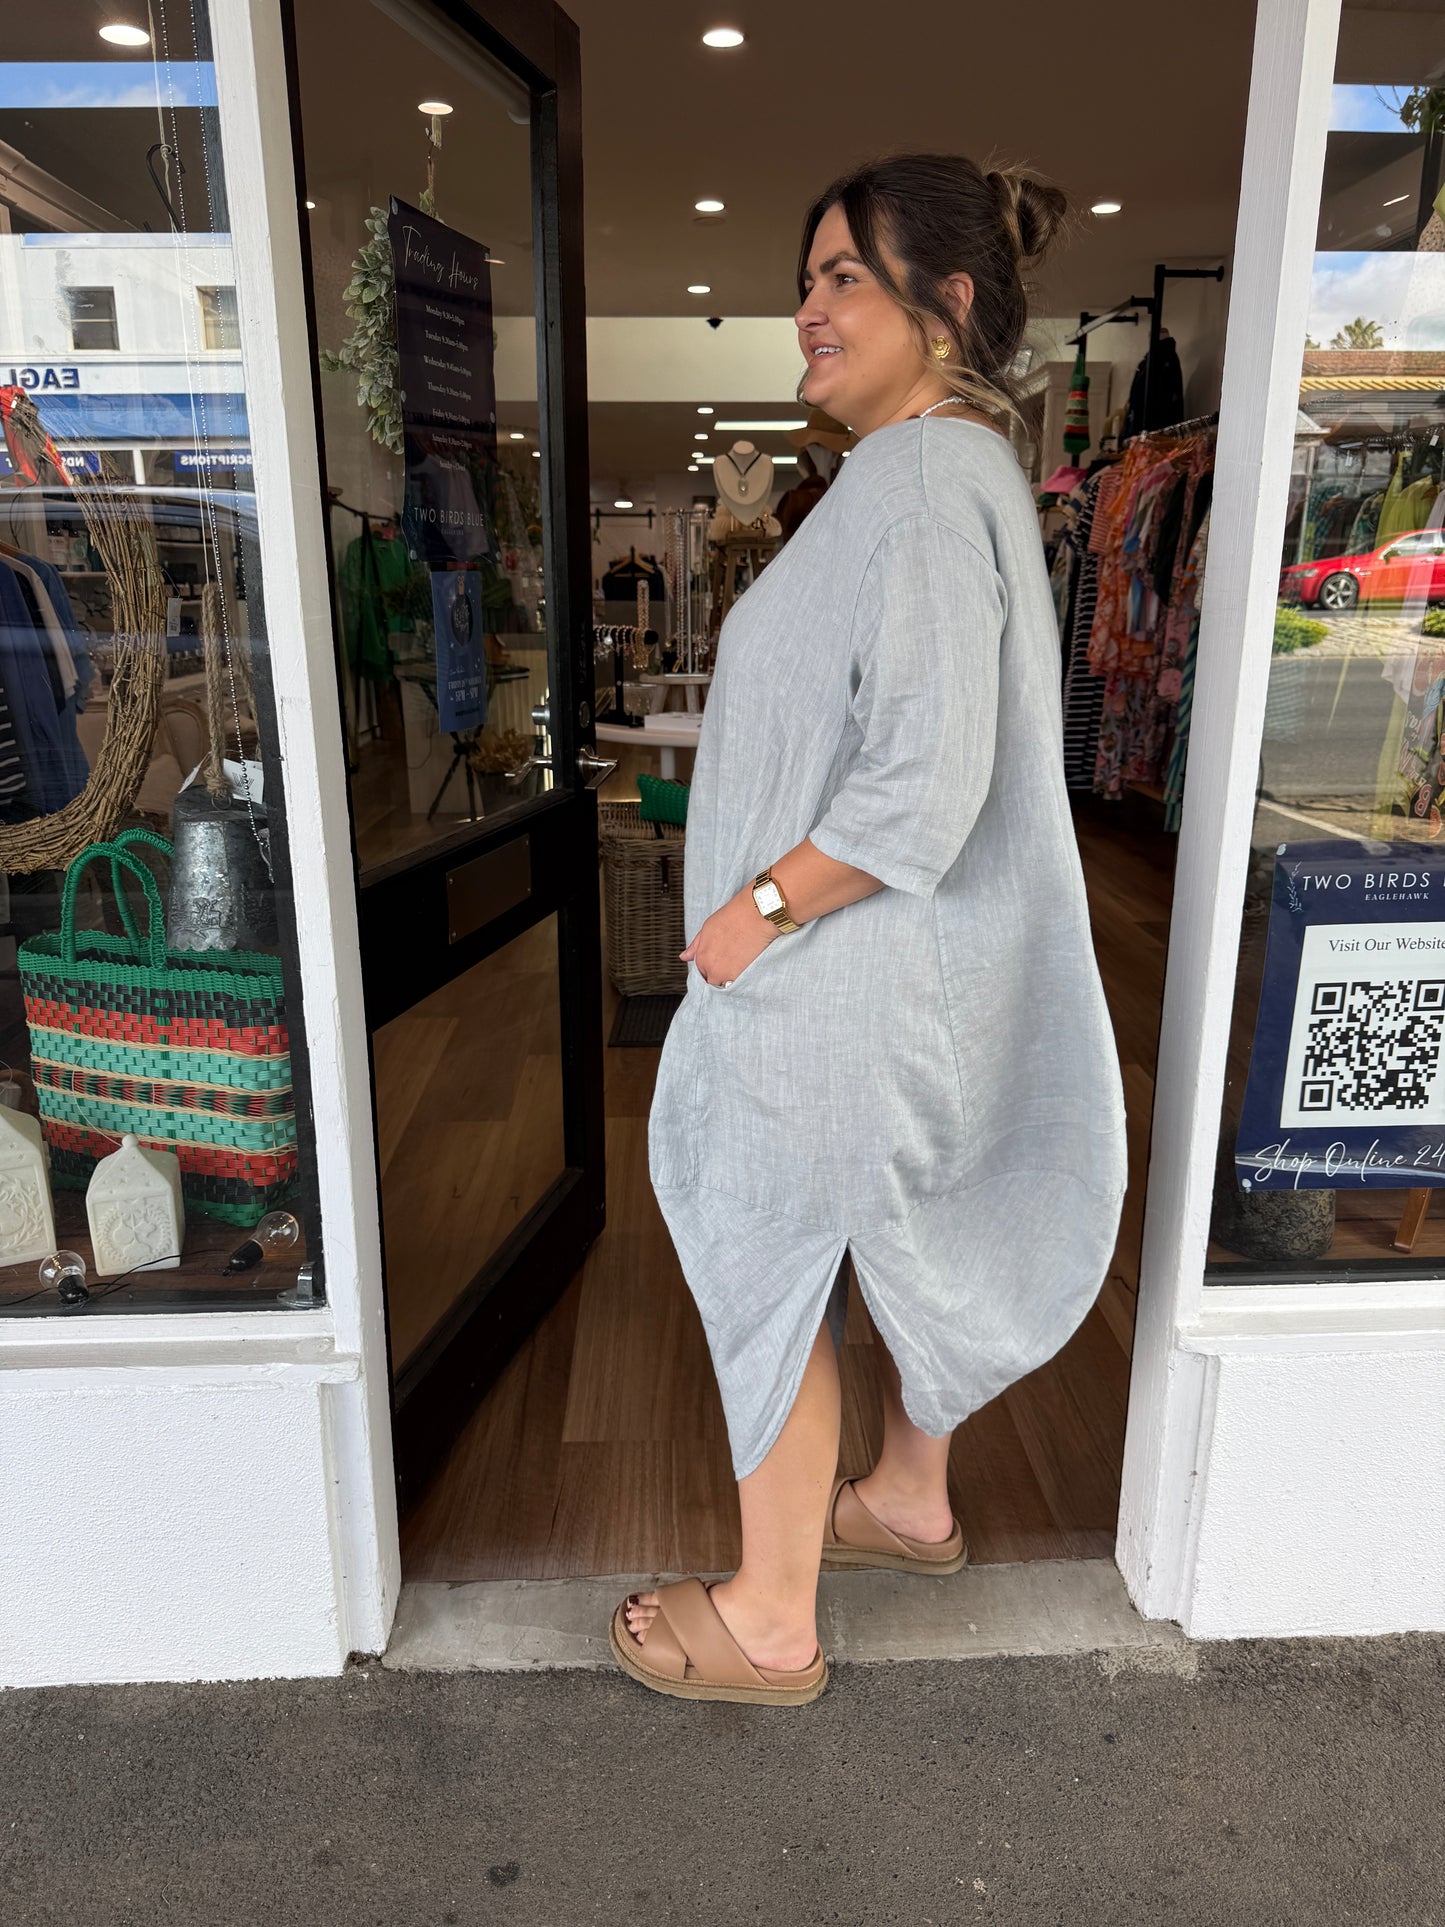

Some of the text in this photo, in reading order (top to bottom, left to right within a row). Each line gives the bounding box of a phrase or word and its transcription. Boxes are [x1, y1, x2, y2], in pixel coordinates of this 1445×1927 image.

[402, 225, 479, 290] Trading Hours
[414, 507, 485, 527] TWO BIRDS BLUE
[1303, 873, 1352, 891] TWO
[1364, 872, 1431, 889] BIRDS
[1364, 891, 1430, 902] EAGLEHAWK
[1328, 939, 1361, 952] Visit
[1364, 938, 1392, 951] Our
[1254, 1138, 1319, 1190] Shop
[1325, 1138, 1408, 1183] Online
